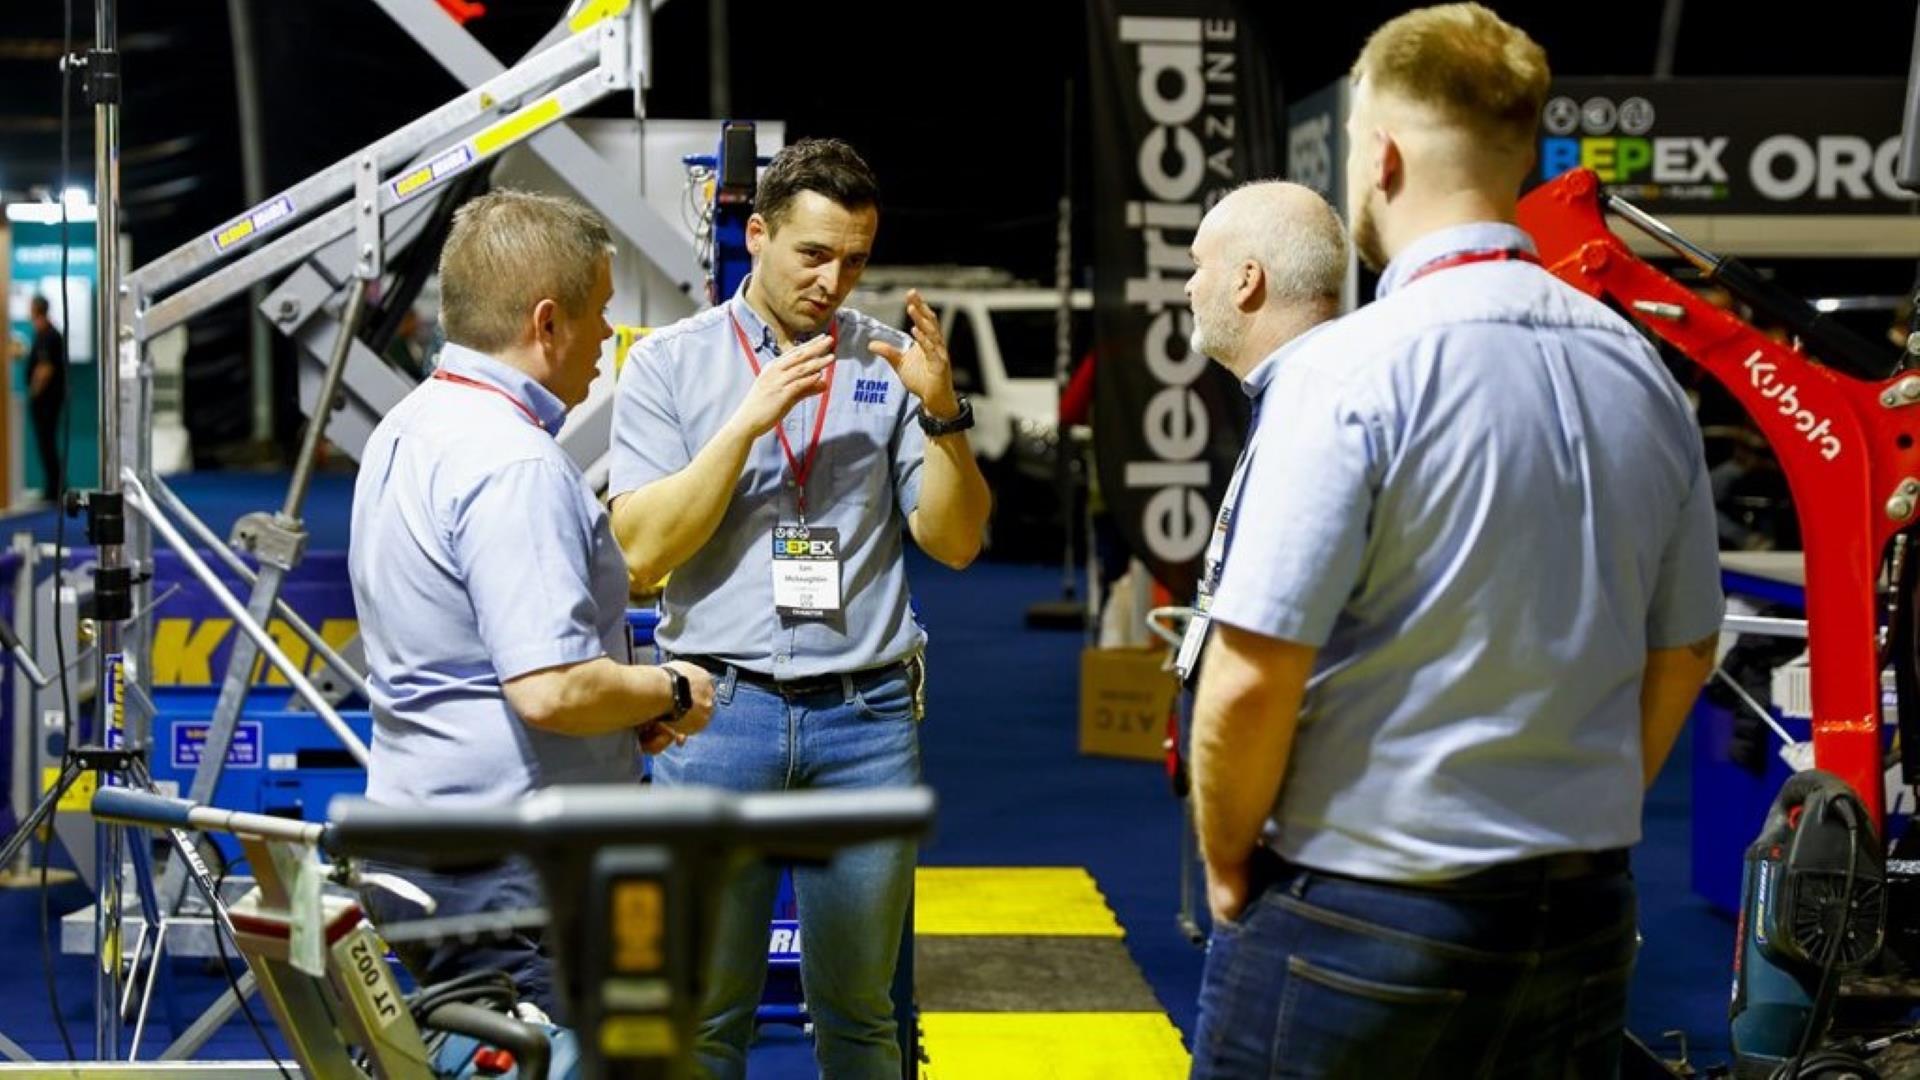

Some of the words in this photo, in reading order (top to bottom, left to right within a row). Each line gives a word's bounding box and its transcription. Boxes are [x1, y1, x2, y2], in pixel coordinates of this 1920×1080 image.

[1542, 136, 1729, 183] BEPEX
[1118, 16, 1213, 563] electrical
[856, 379, 889, 392] KDM
[1744, 350, 1841, 461] Kubota
[775, 539, 834, 555] BEPEX
[1095, 706, 1156, 735] ATC
[351, 940, 380, 988] 002
[373, 991, 397, 1018] JT
